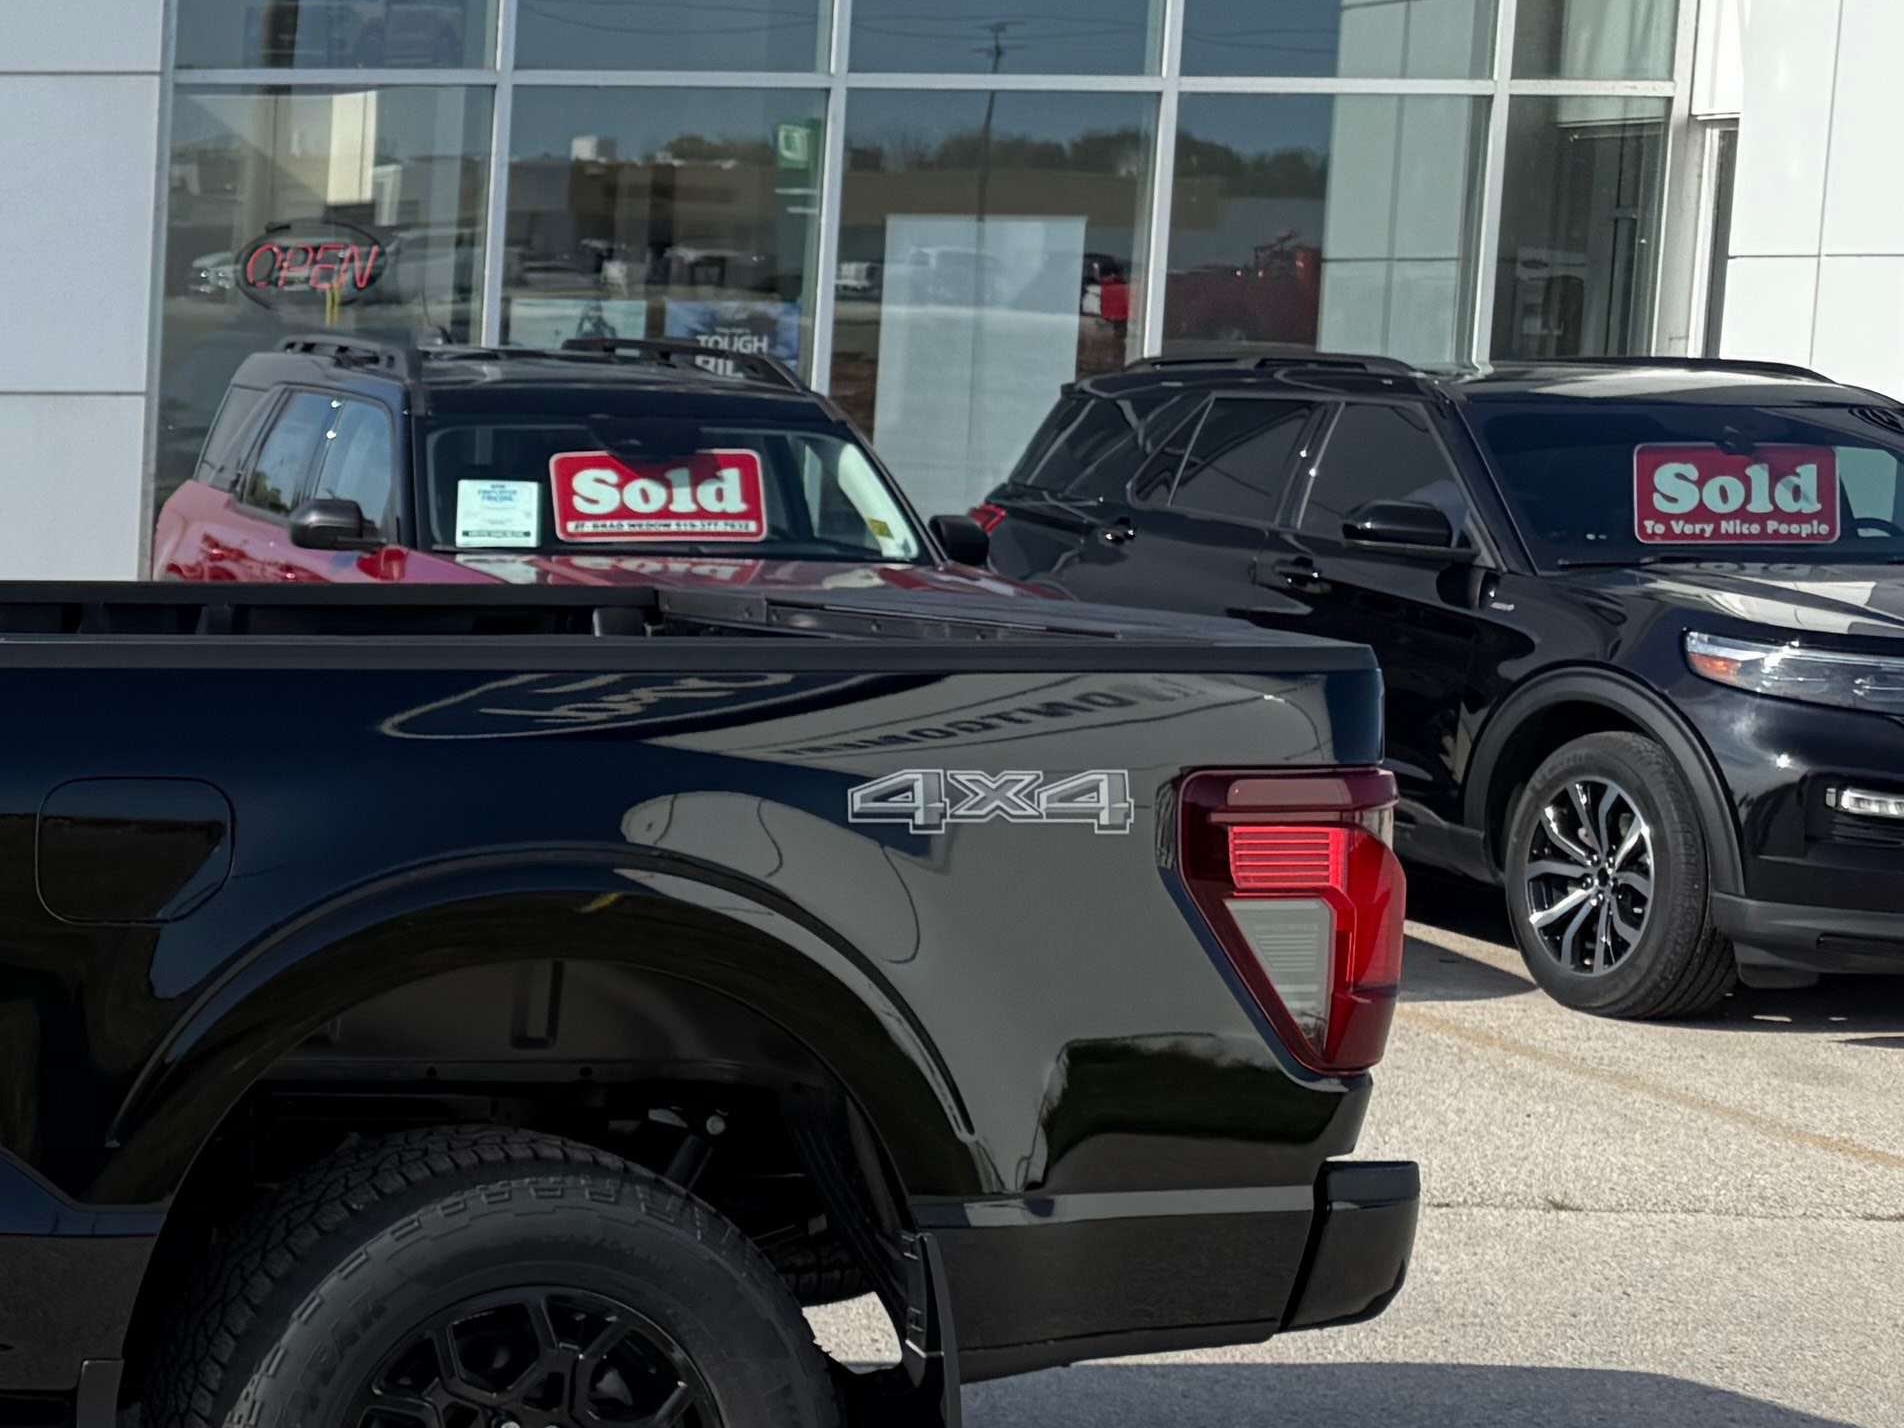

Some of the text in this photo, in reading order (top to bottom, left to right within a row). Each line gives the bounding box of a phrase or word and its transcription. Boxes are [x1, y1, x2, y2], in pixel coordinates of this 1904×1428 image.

[246, 243, 380, 289] OPEN
[695, 335, 769, 354] TOUGH
[571, 468, 748, 514] Sold
[1652, 462, 1823, 514] Sold
[1643, 520, 1830, 538] To Very Nice People
